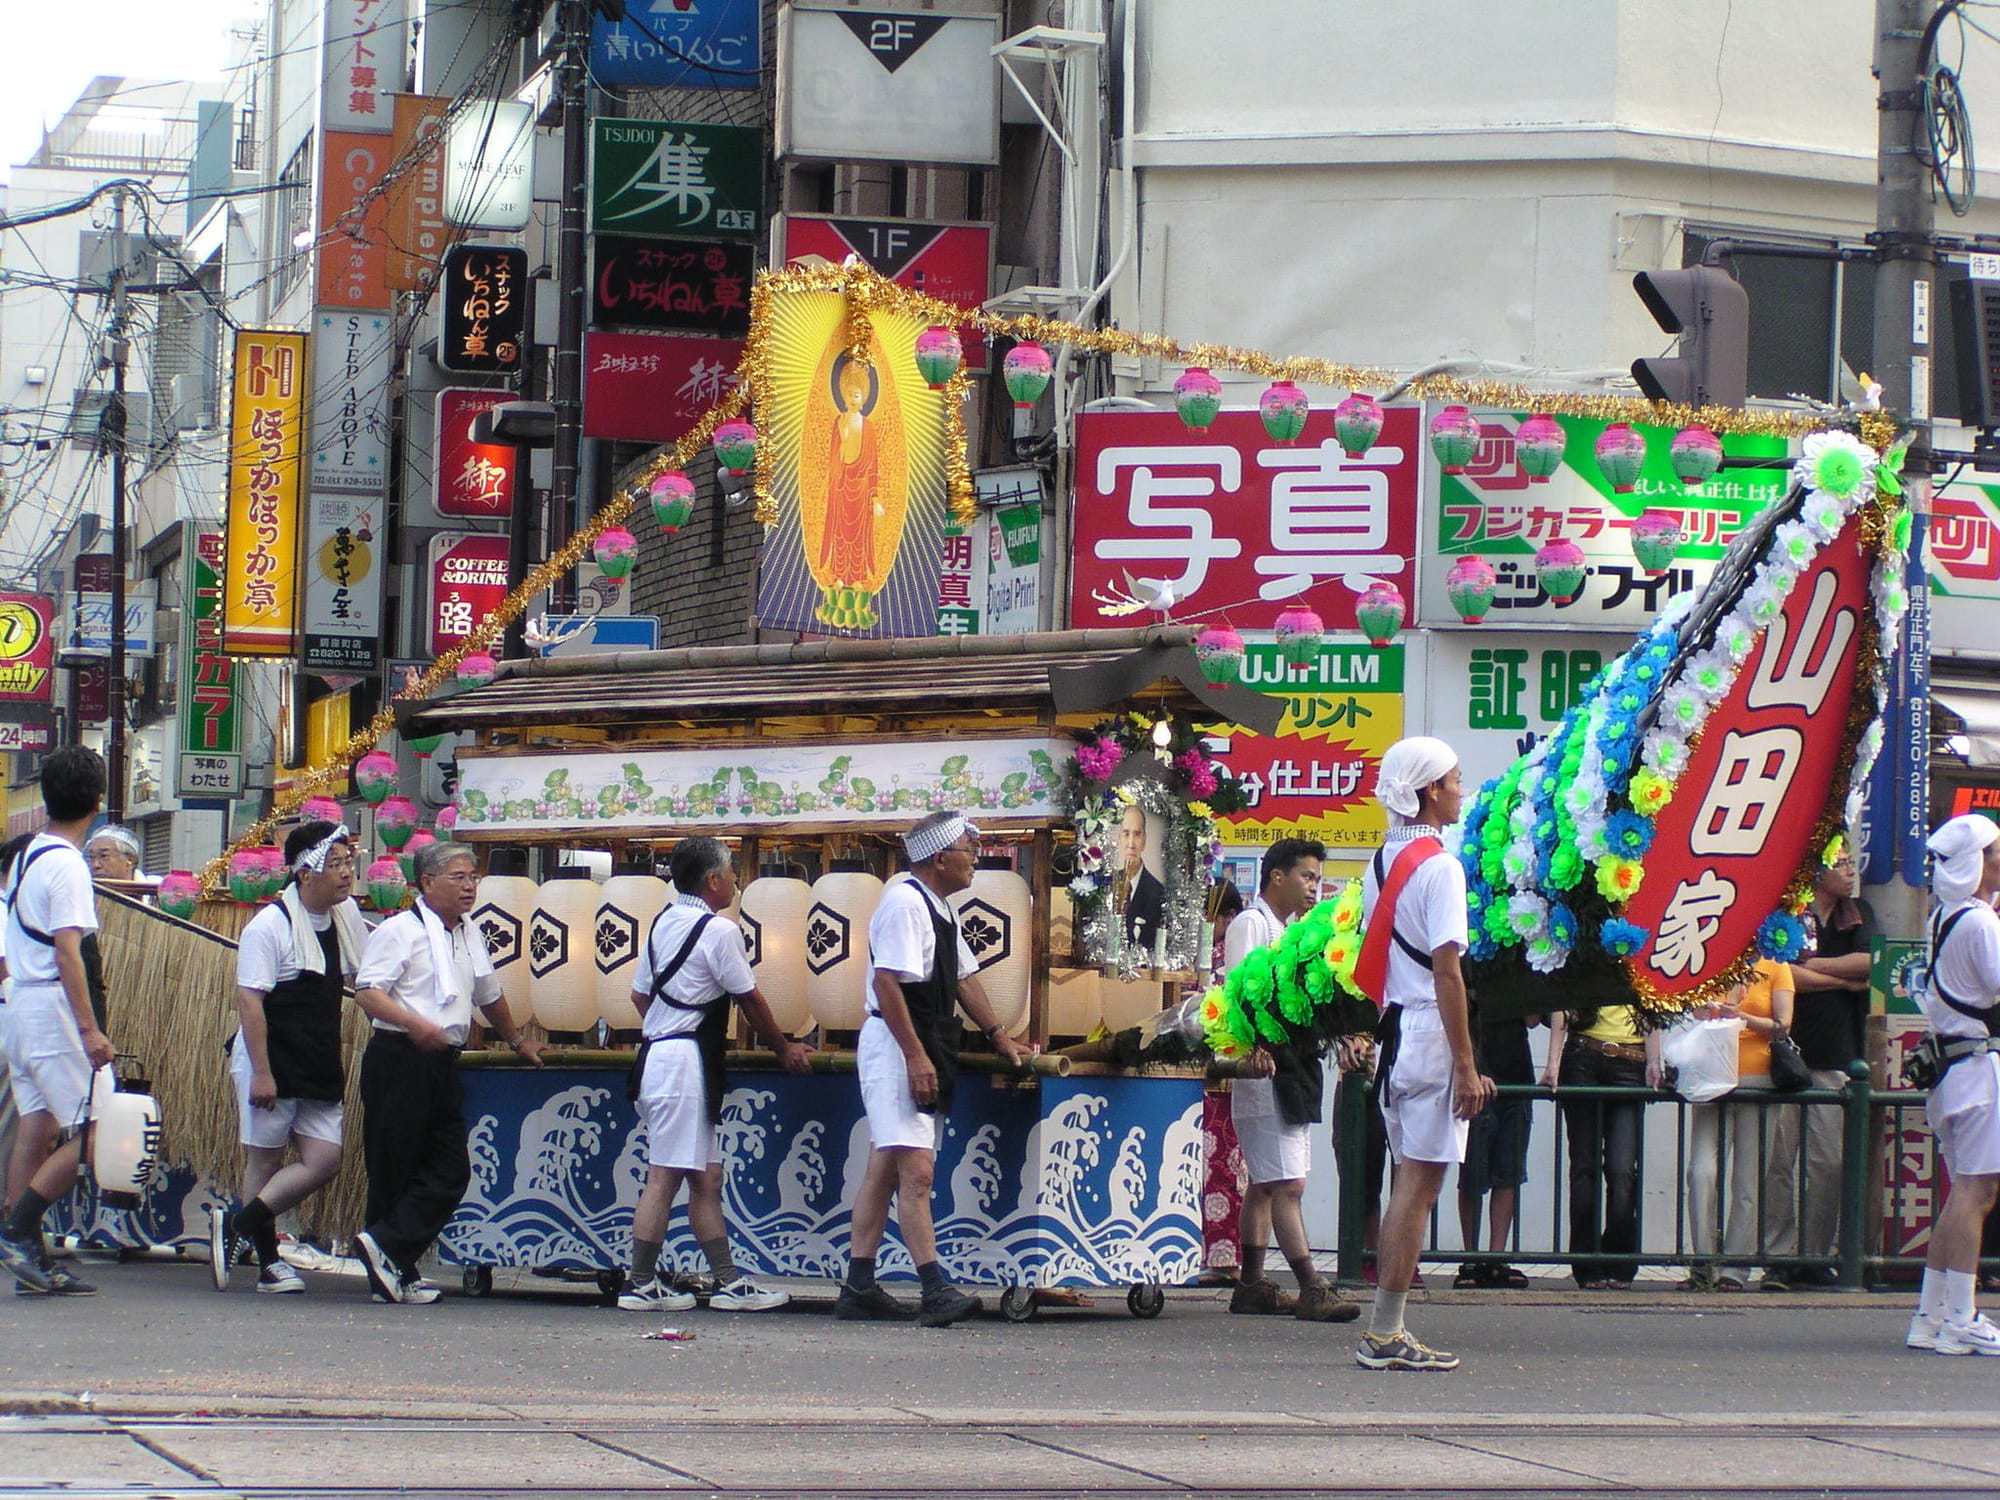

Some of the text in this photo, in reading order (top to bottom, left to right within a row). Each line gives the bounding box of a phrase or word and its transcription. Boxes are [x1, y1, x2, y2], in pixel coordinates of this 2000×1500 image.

[604, 21, 747, 65] 青いりんご
[870, 20, 916, 50] 2F
[604, 127, 655, 143] TSUDOI
[719, 212, 753, 228] 4F
[868, 228, 910, 258] 1F
[637, 249, 696, 270] スナック
[1972, 257, 2000, 275] 待ち
[494, 255, 511, 315] スナック
[600, 257, 746, 318] いちねん草
[460, 255, 490, 361] いちねん草
[244, 408, 285, 614] ほっかほっか亭
[1095, 438, 1405, 601] 写真
[1008, 523, 1038, 549] FUJIFILM
[444, 558, 509, 572] COFFEE
[987, 574, 1036, 624] Digital Print
[73, 601, 147, 633] Flffy
[439, 602, 473, 635] 路
[1909, 584, 1925, 686] 県庁正門左下
[0, 662, 47, 691] aily
[1239, 654, 1380, 684] UJIFILM
[1286, 697, 1373, 729] リント
[0, 727, 20, 745] 24
[193, 757, 228, 769] 写真の
[1650, 569, 1857, 979] 山田家
[190, 773, 230, 788] わたせ
